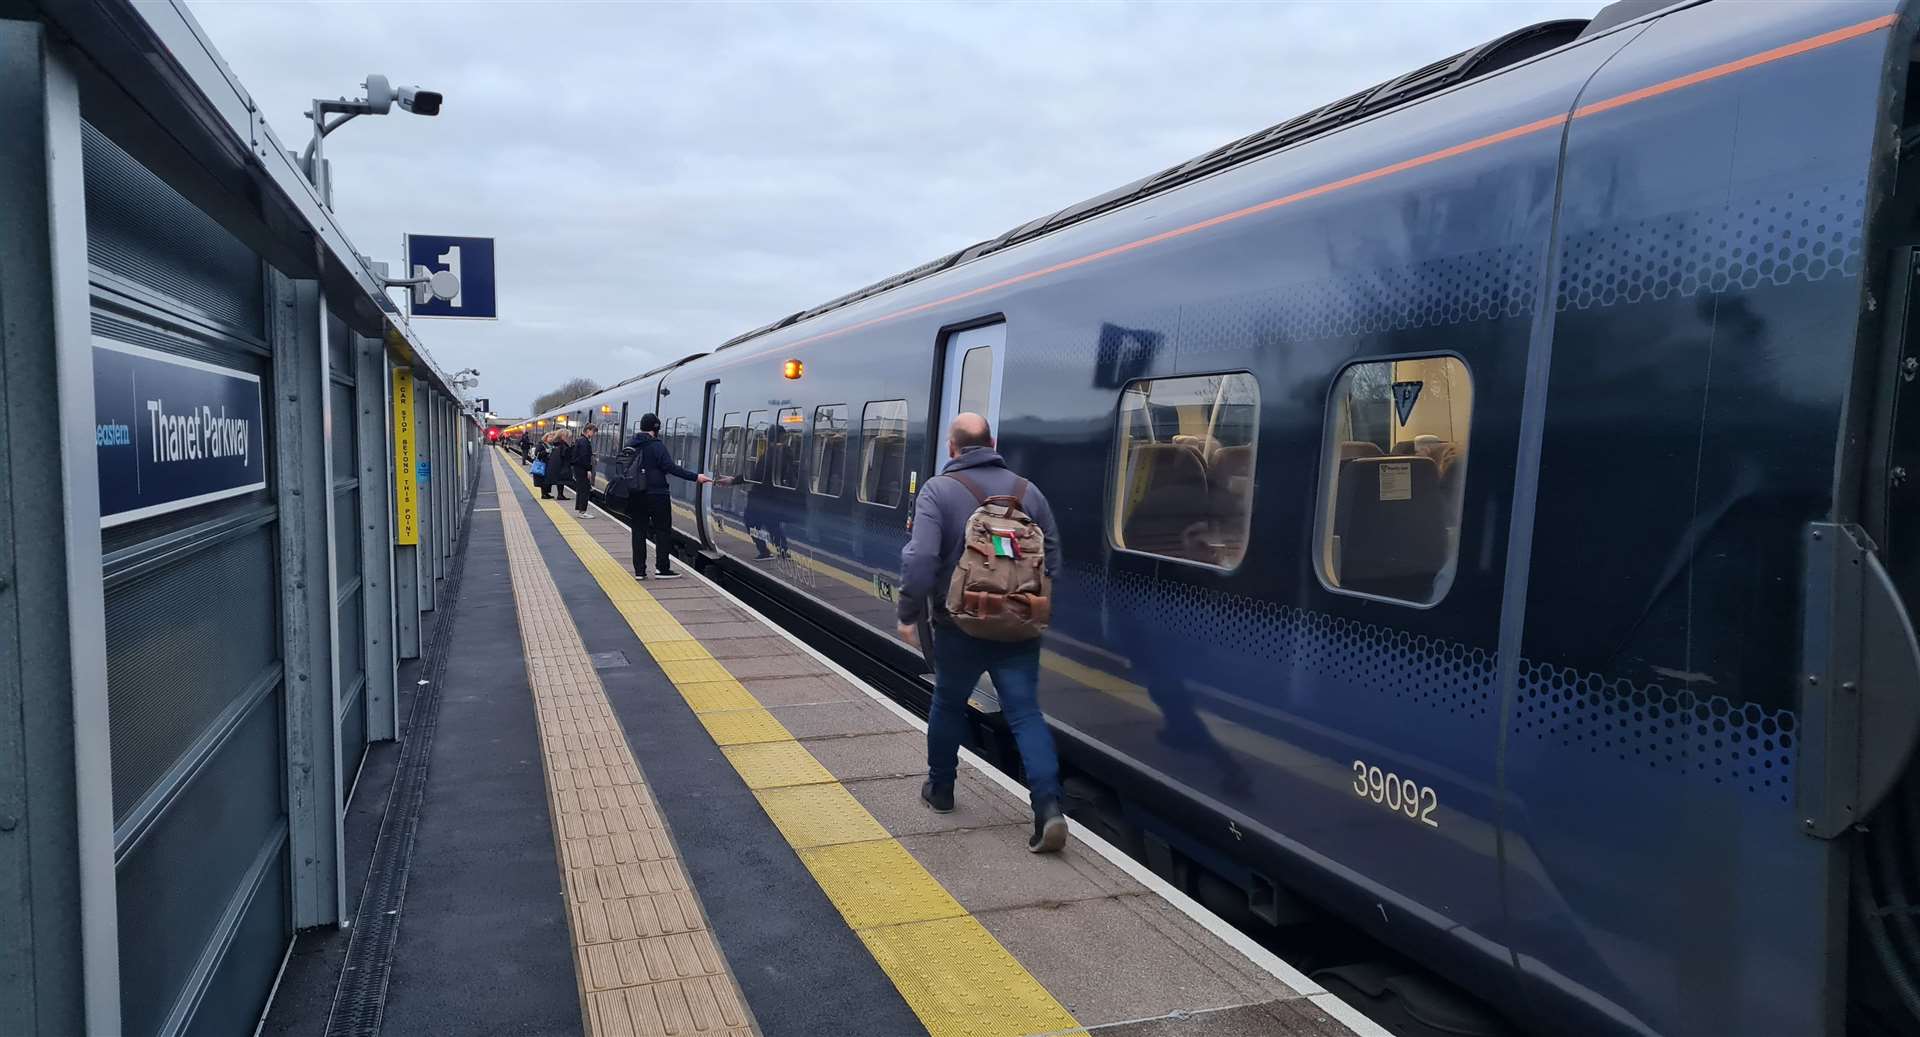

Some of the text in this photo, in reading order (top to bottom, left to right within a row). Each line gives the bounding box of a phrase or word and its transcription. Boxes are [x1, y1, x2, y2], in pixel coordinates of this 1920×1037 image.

[438, 246, 462, 307] 1
[147, 399, 249, 467] Thanet Parkway
[1353, 760, 1438, 828] 39092
